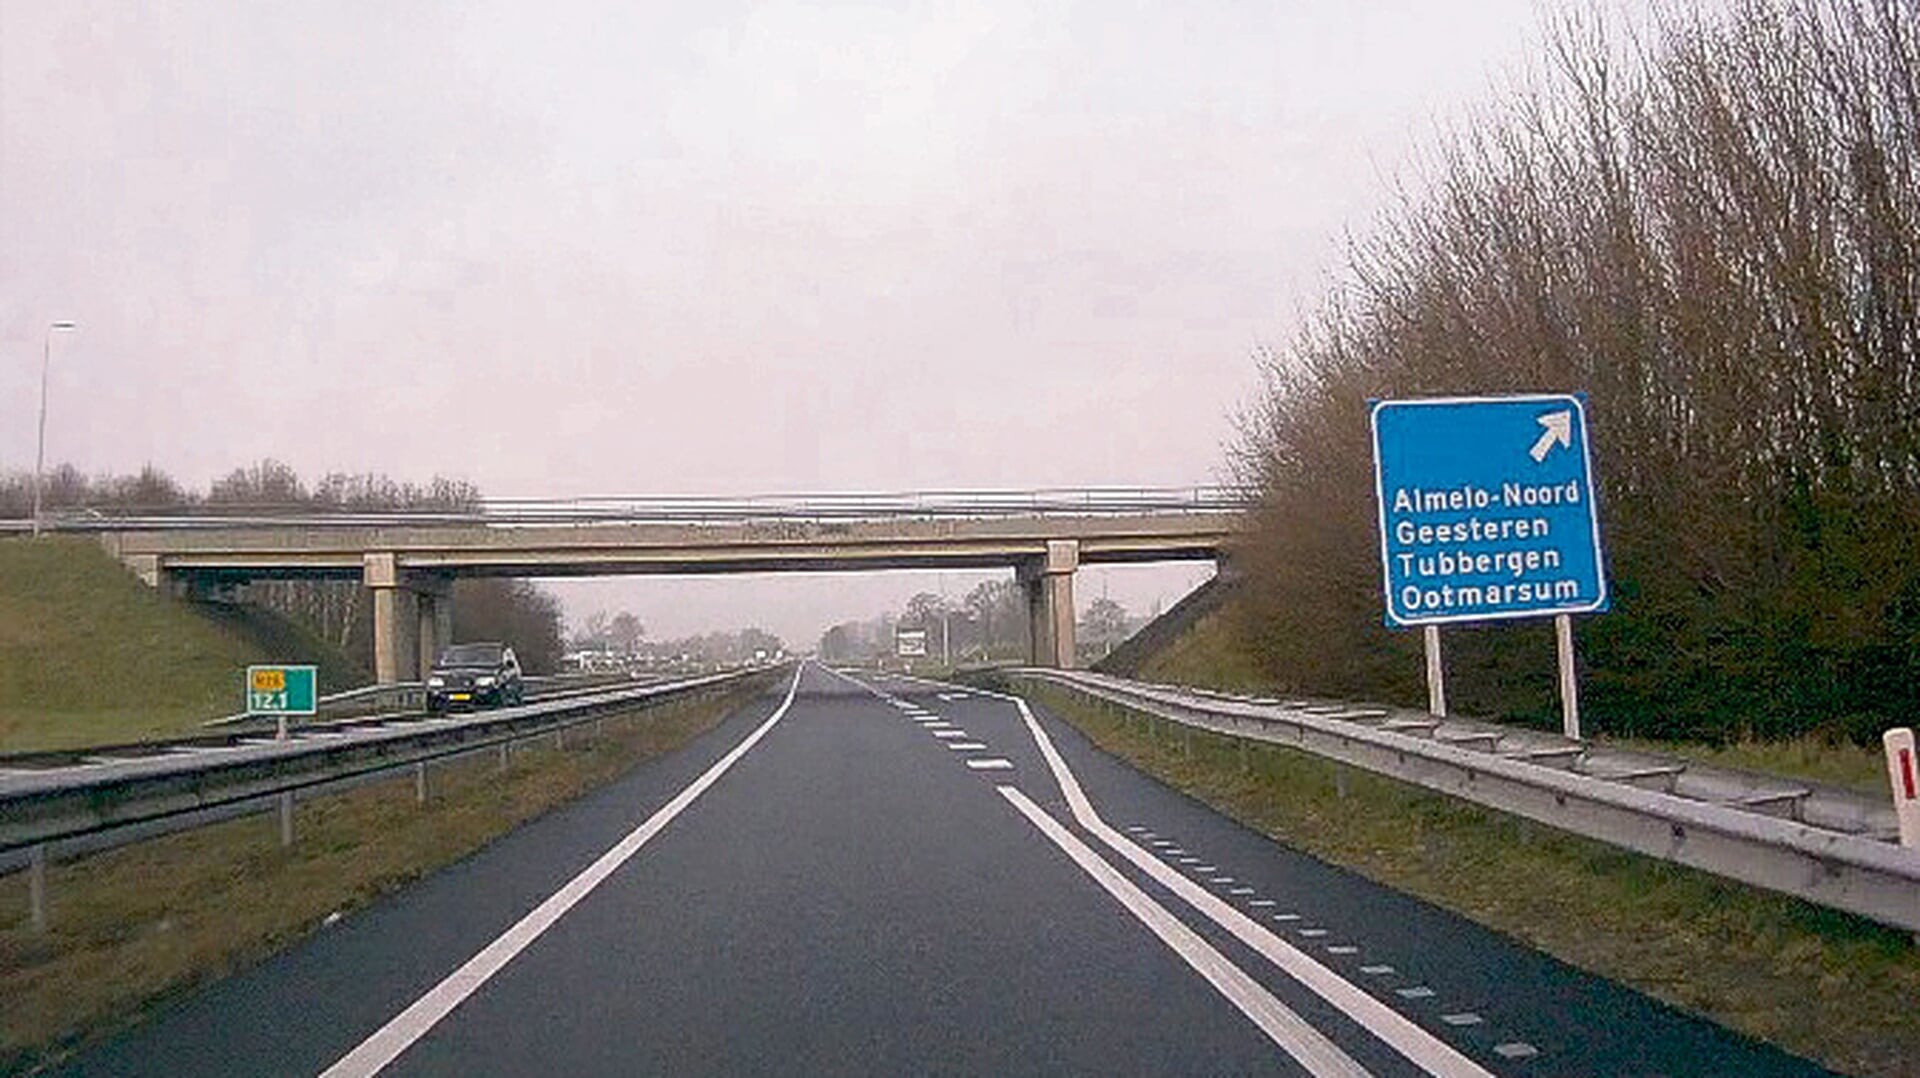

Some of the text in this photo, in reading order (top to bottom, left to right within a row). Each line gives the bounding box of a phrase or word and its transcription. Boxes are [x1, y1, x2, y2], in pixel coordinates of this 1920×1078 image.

[1394, 480, 1580, 512] Almelo-Noord
[1396, 517, 1549, 544] Geesteren
[1397, 550, 1559, 577] Tubbergen
[1402, 579, 1579, 609] Ootmarsum
